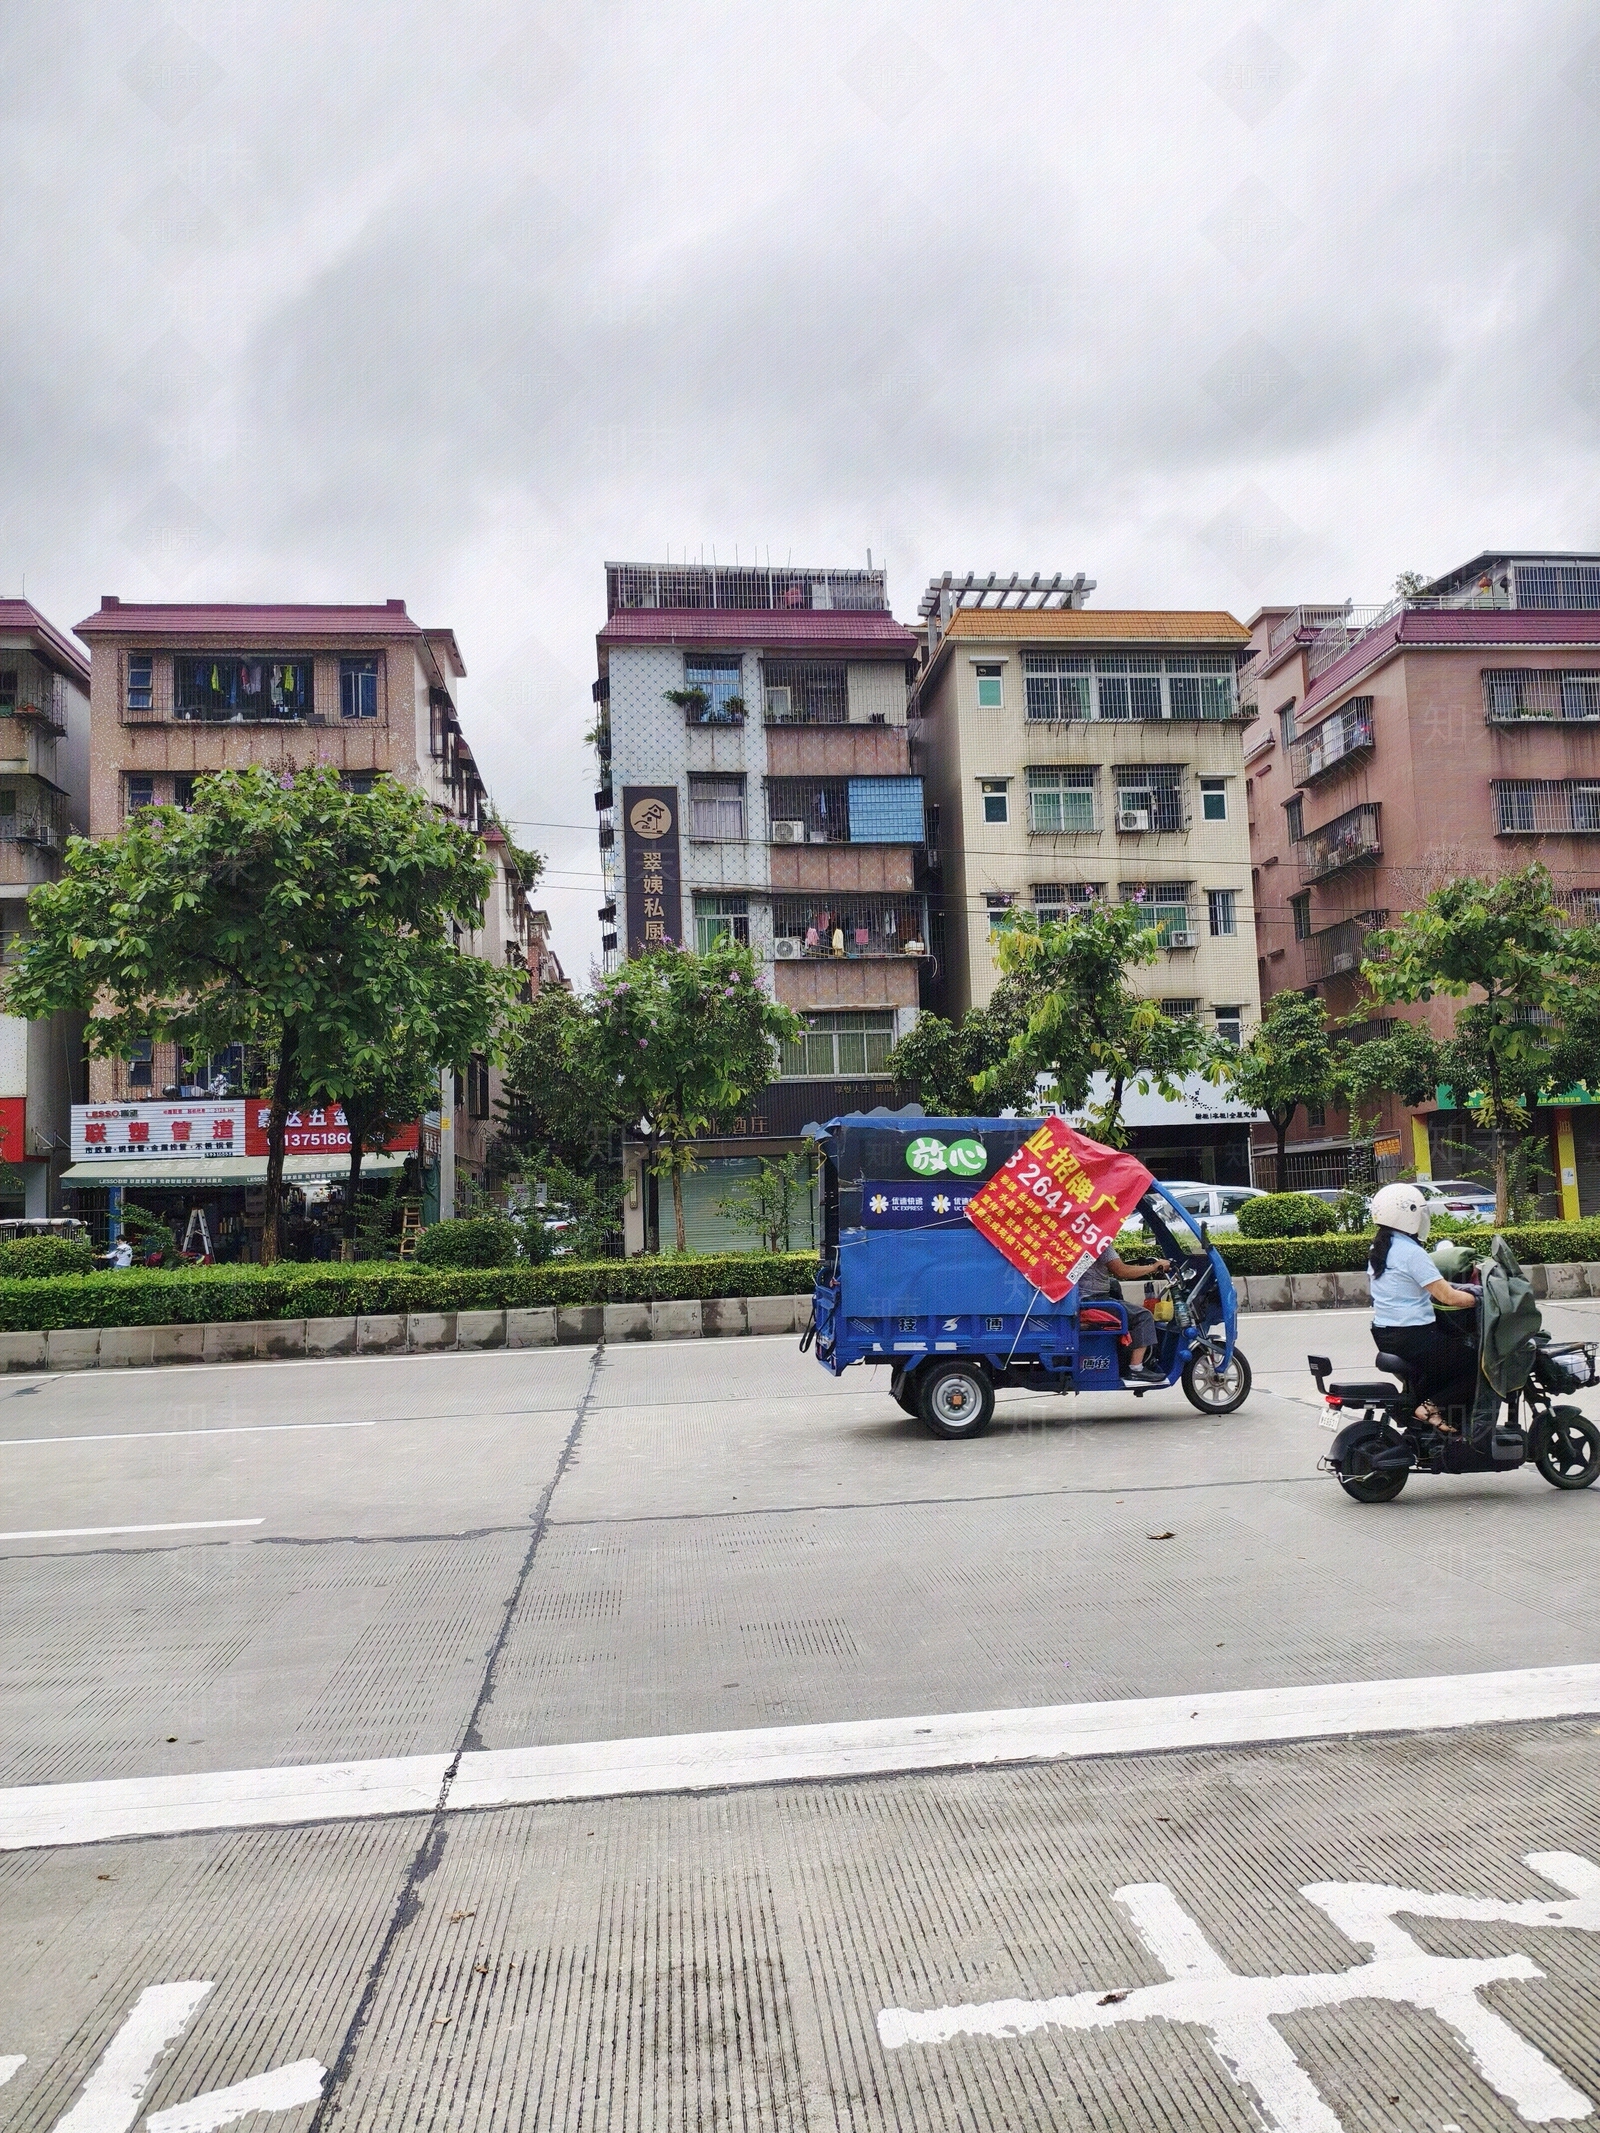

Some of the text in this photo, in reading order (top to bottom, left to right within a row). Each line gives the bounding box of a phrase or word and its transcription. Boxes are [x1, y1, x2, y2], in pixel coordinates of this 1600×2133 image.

[642, 852, 665, 941] 翠姨私厨
[85, 1118, 235, 1144] 联塑管道
[86, 1110, 120, 1119] LESSO
[911, 1138, 988, 1171] 放心
[1024, 1126, 1126, 1222] 业招牌广
[1017, 1163, 1073, 1218] 2641
[981, 1194, 1006, 1218] 宣传单
[1042, 1250, 1067, 1274] 不干胶
[999, 1193, 1024, 1215] 水晶字
[1049, 1239, 1075, 1262] PVC字
